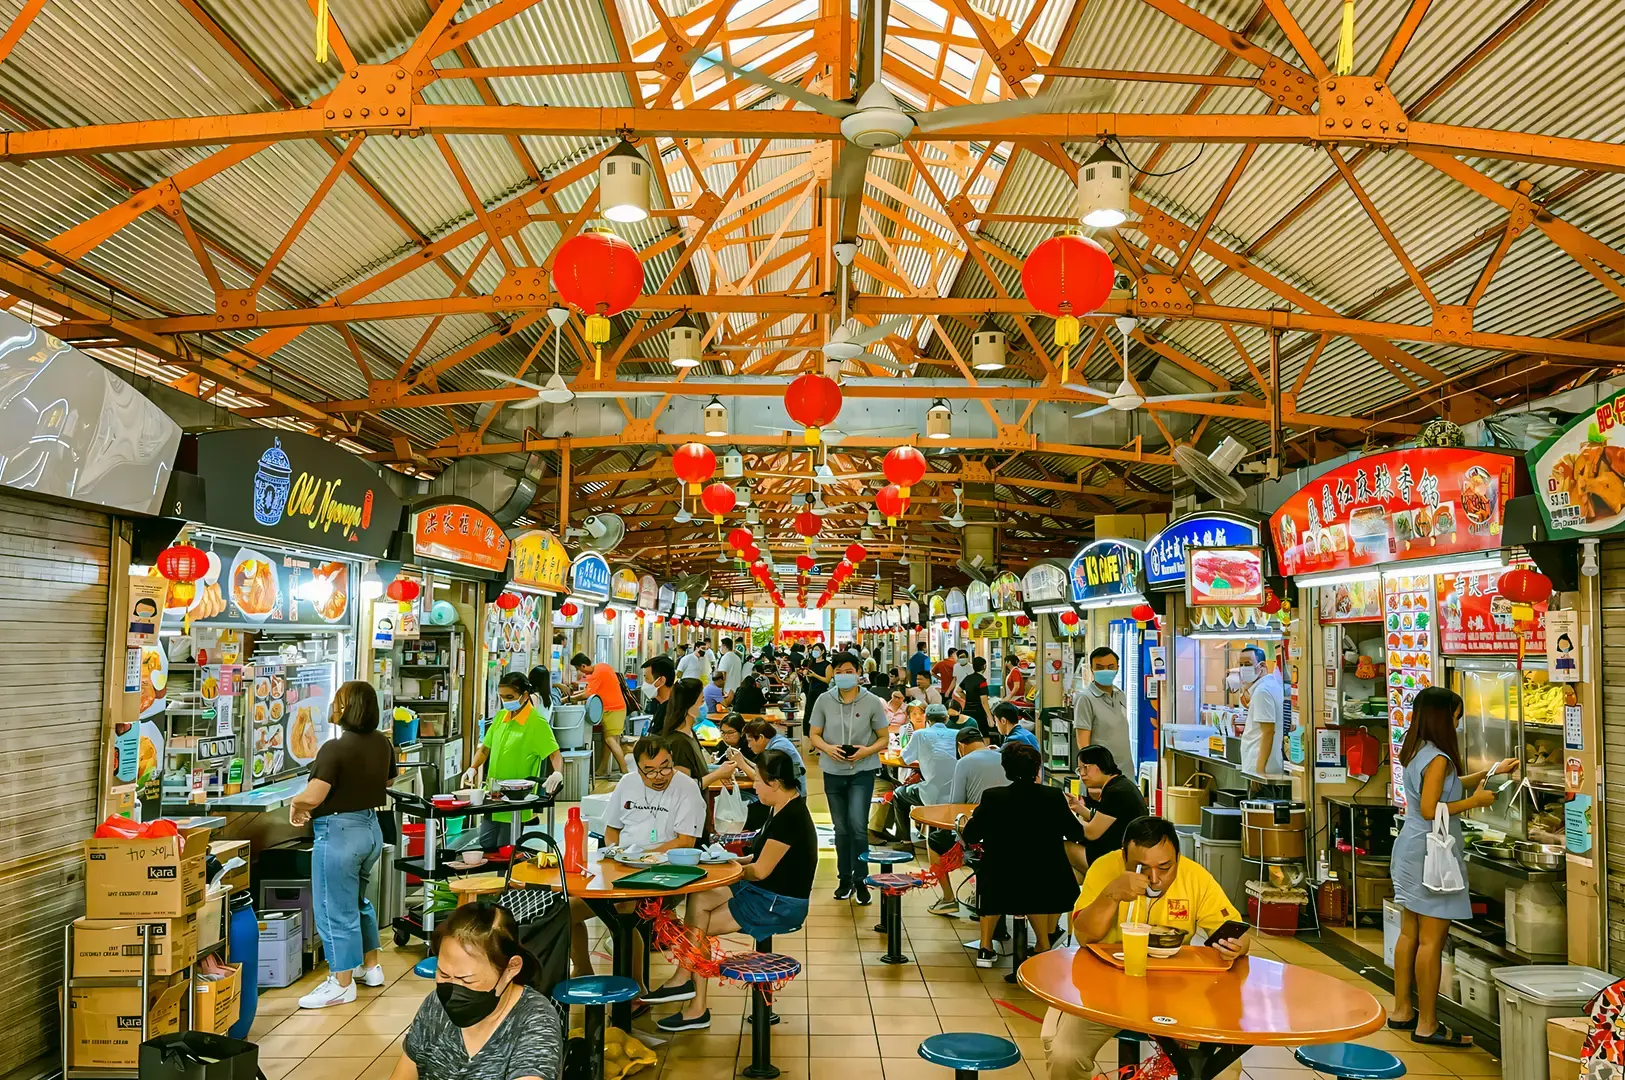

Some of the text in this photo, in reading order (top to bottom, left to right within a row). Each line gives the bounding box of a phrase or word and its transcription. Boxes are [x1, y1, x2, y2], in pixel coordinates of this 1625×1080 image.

[175, 501, 182, 515] 3
[287, 472, 363, 537] Old Nyonya
[1086, 554, 1120, 586] K3 CAFE
[624, 800, 669, 814] Champion
[150, 867, 175, 879] kara
[119, 1016, 142, 1029] kara
